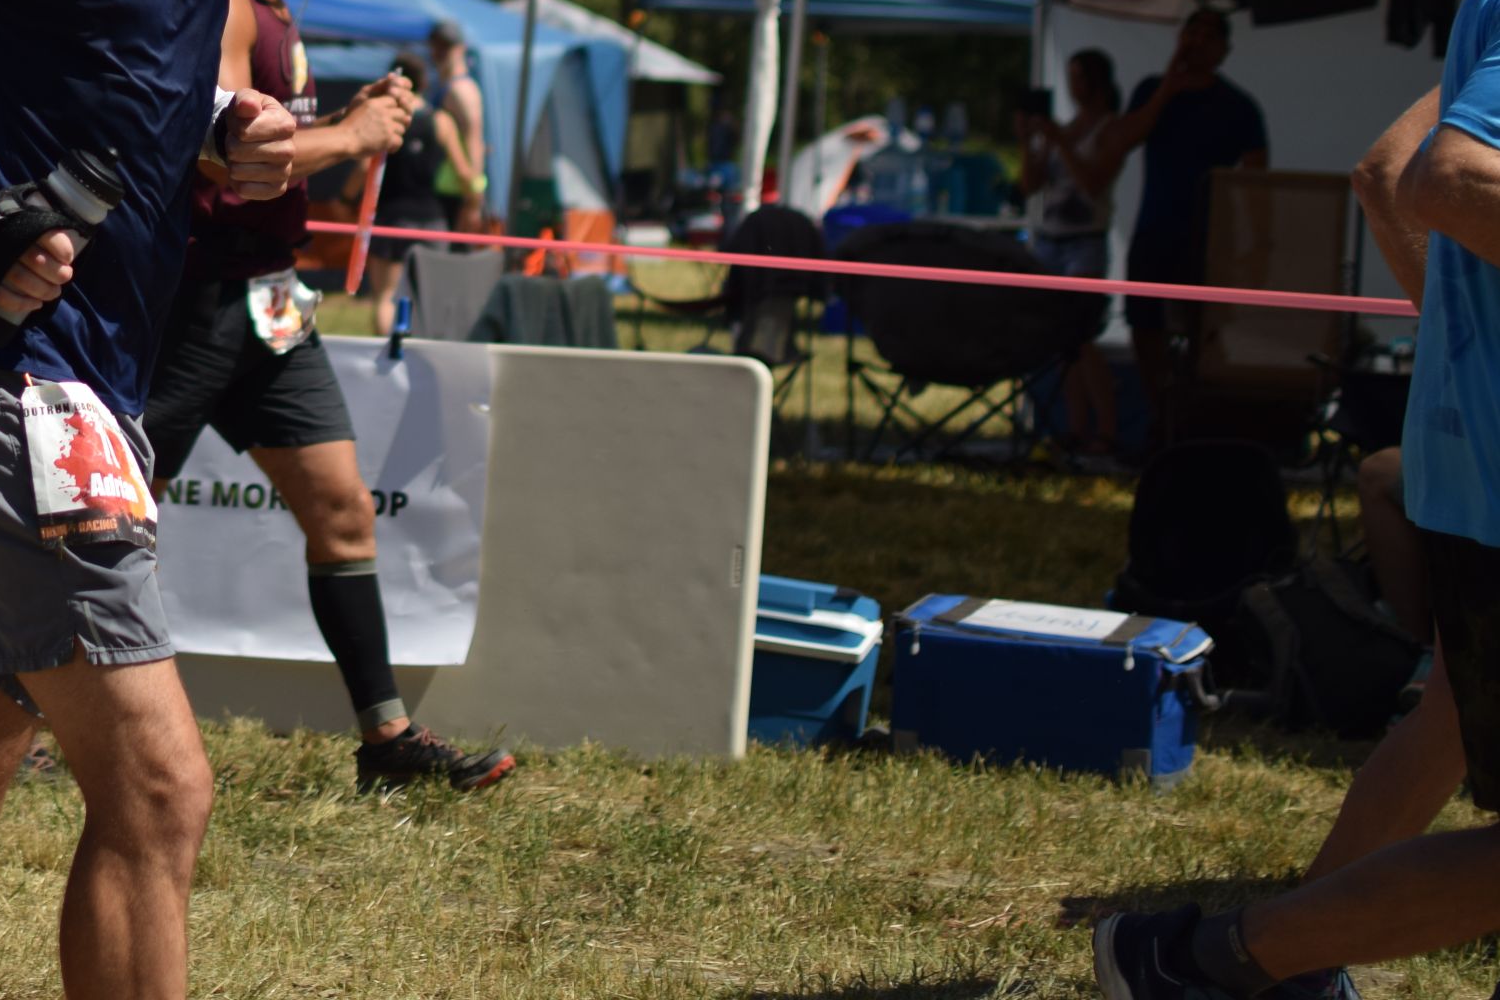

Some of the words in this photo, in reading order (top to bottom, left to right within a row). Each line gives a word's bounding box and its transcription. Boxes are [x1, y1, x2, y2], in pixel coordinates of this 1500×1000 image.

[23, 401, 71, 418] OUTRUN
[158, 479, 202, 506] NE
[211, 481, 290, 511] MOR
[369, 488, 410, 517] OP
